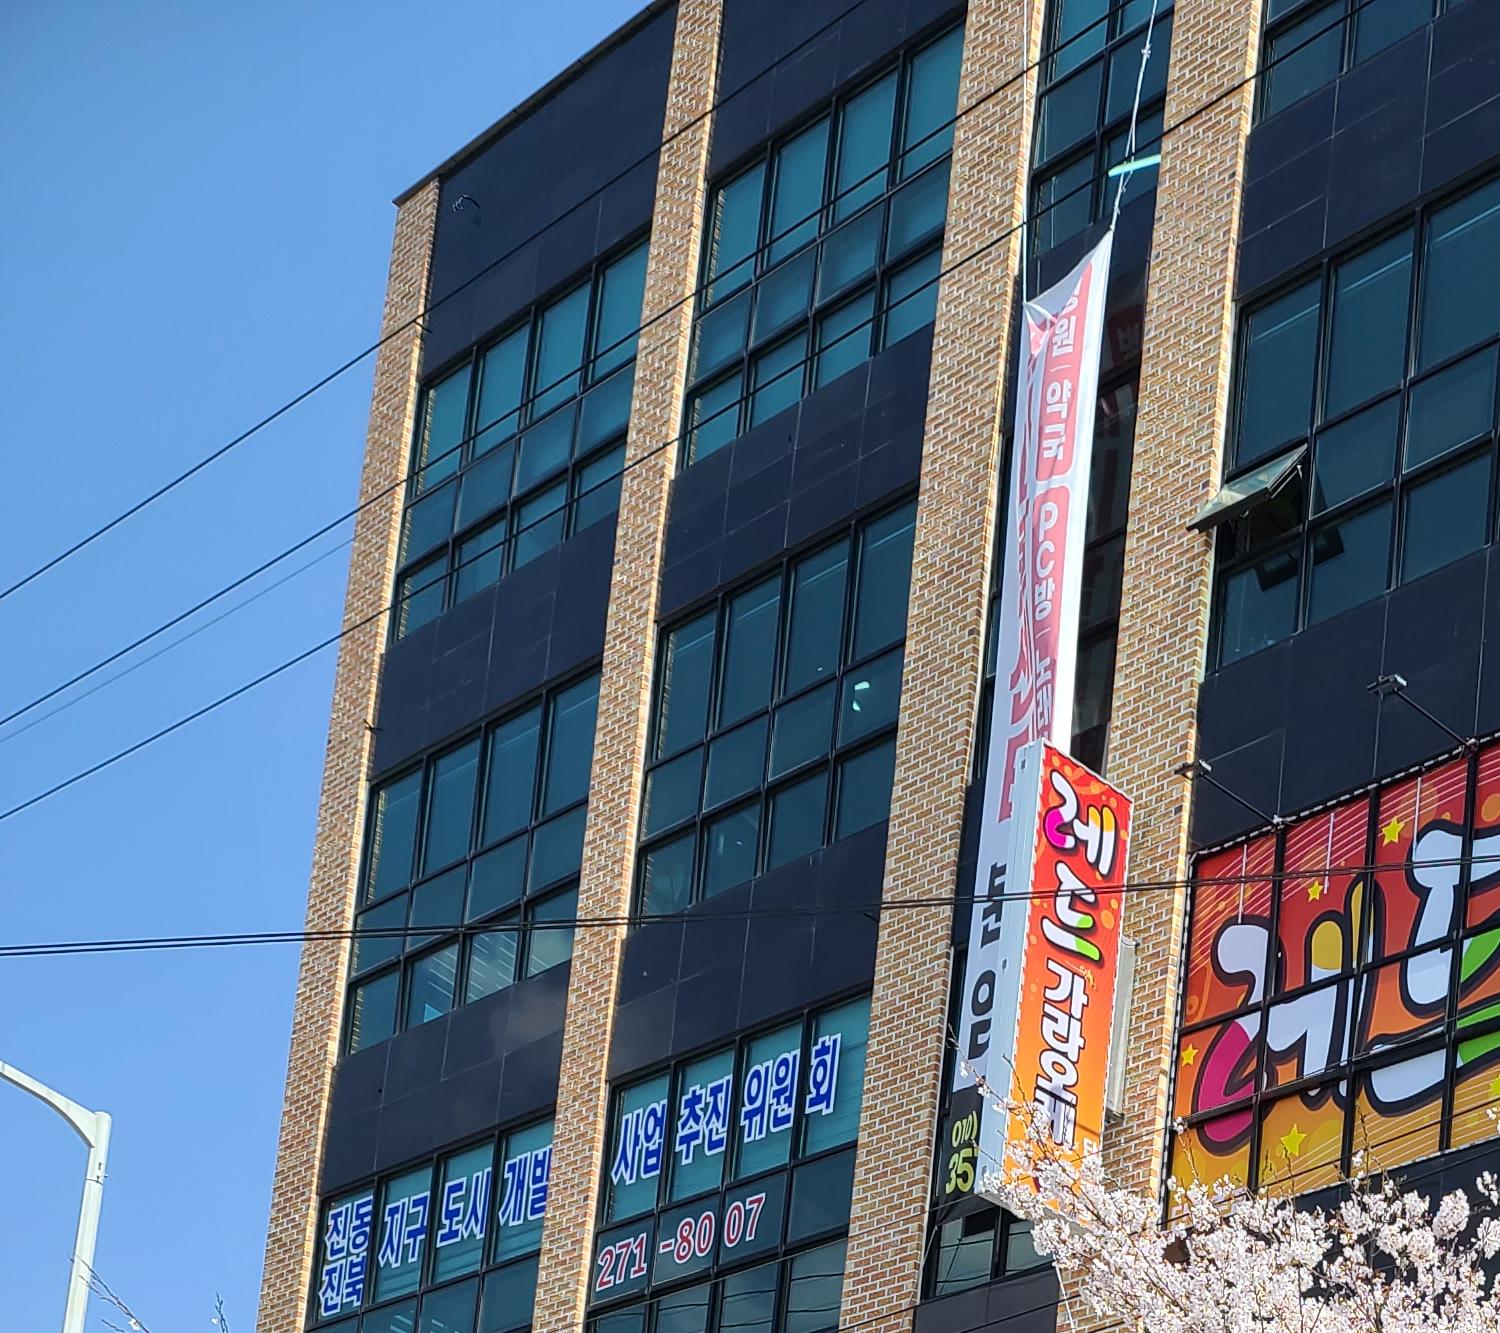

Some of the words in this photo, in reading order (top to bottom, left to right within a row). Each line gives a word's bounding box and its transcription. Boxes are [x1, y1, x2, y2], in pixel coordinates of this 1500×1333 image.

[1044, 380, 1071, 461] 약국
[1034, 502, 1058, 620] PC방
[1033, 957, 1089, 1147] 가라오케
[611, 1100, 668, 1185] 사업
[675, 1074, 733, 1165] 추진
[325, 1195, 373, 1261] 진동
[378, 1191, 430, 1268] 지구
[436, 1167, 493, 1248] 도시
[499, 1146, 552, 1227] 개발
[319, 1252, 367, 1316] 진북
